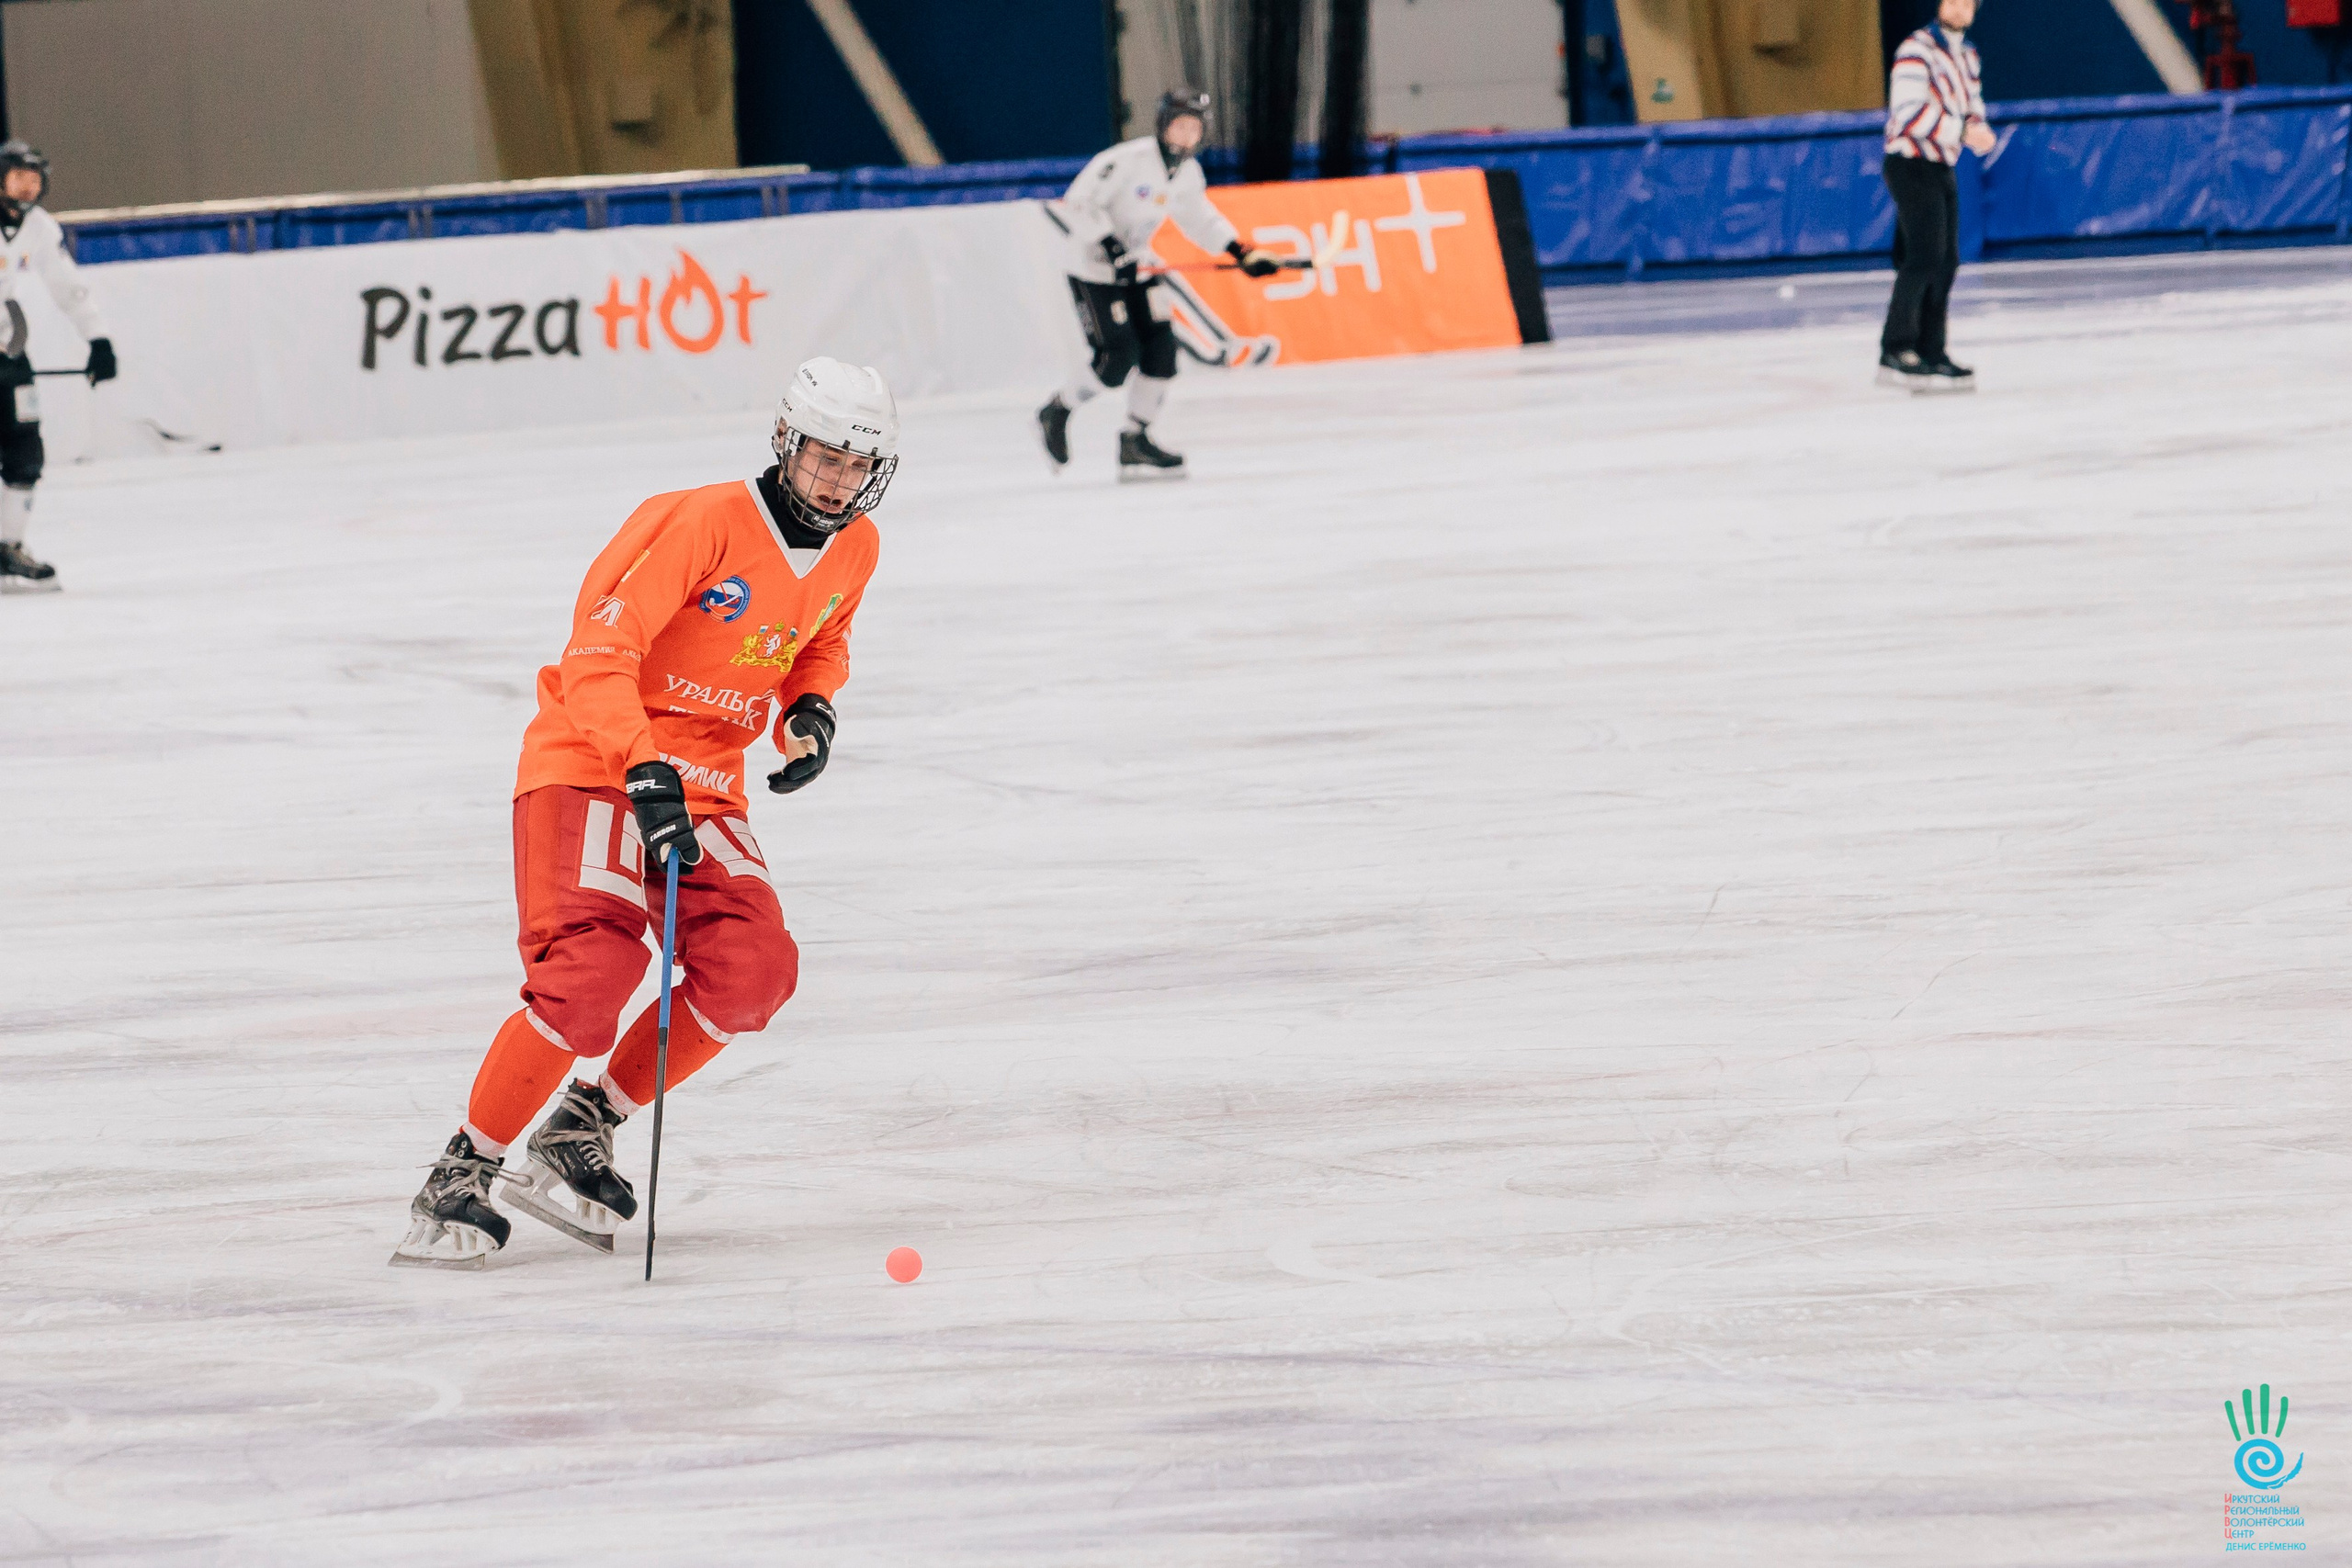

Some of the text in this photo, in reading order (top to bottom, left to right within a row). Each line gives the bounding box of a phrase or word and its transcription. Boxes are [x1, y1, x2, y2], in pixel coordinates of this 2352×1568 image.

[359, 286, 582, 371] Pizza
[851, 423, 882, 436] CCM
[650, 824, 676, 841] CARBON
